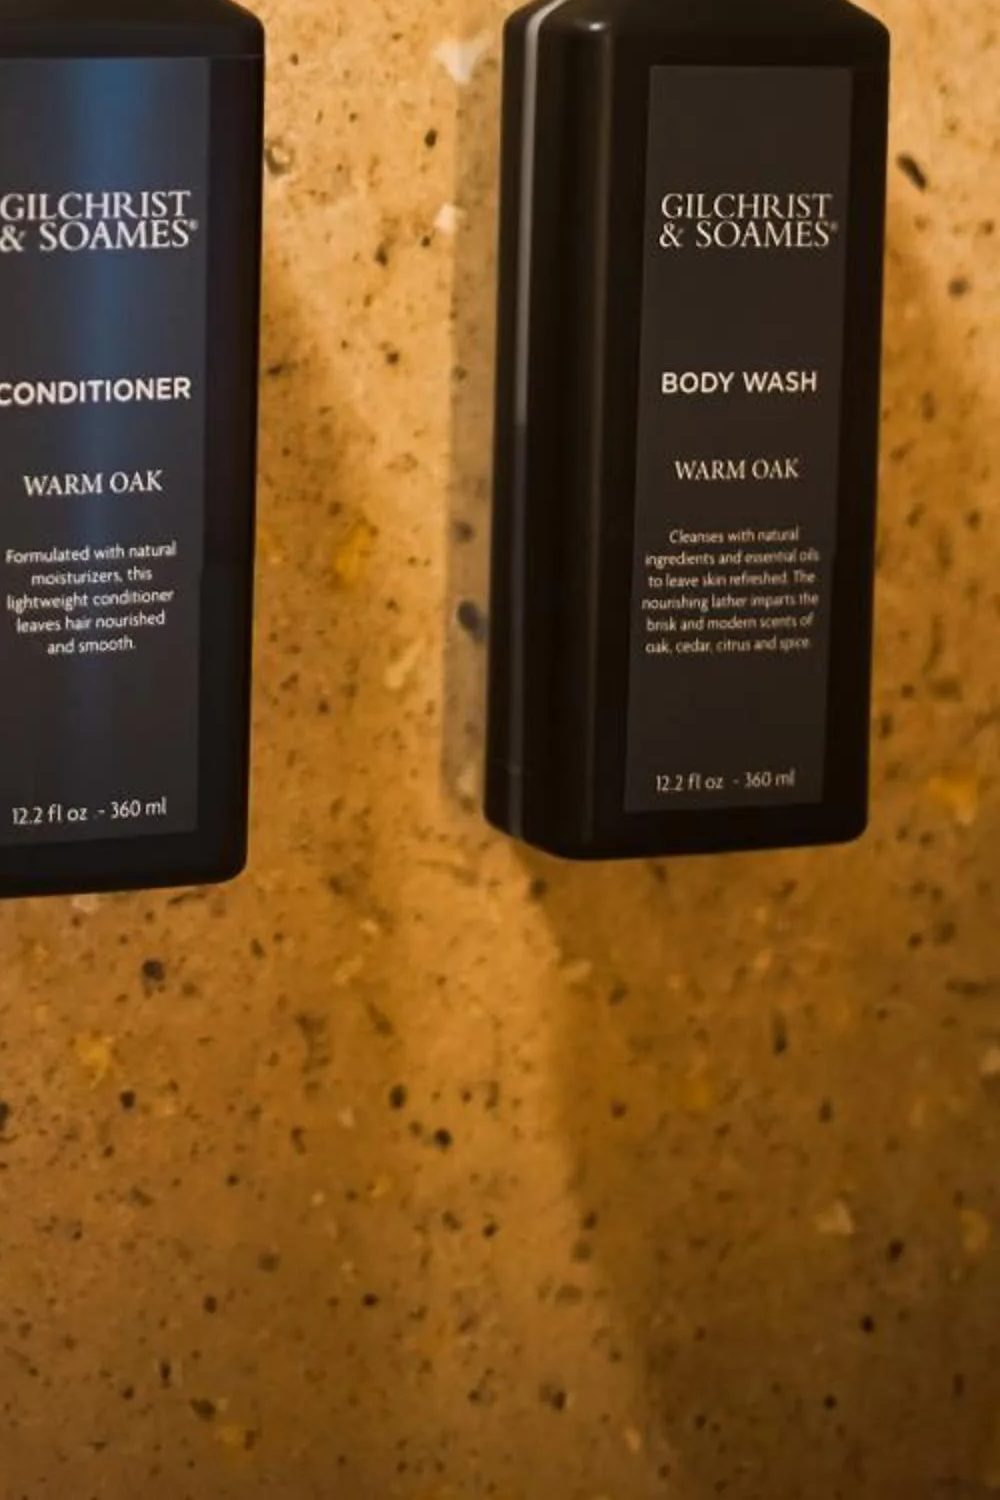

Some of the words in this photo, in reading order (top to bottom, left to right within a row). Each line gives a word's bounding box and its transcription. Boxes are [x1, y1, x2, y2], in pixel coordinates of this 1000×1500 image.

[0, 190, 192, 221] GILCHRIST
[661, 192, 834, 219] GILCHRIST
[659, 221, 684, 248] &
[661, 371, 735, 394] BODY
[742, 370, 818, 393] WASH
[674, 459, 746, 481] WARM
[751, 457, 800, 479] OAK
[23, 473, 102, 497] WARM
[109, 469, 163, 493] OAK
[669, 528, 724, 544] Cleanses
[727, 527, 755, 543] with
[757, 525, 800, 542] natural
[5, 545, 90, 564] Formulated
[93, 543, 125, 560] with
[128, 540, 177, 558] natural
[645, 551, 715, 570] ingredients
[718, 549, 742, 565] and
[127, 565, 153, 582] this
[648, 574, 663, 588] to
[665, 573, 699, 588] leave
[702, 571, 727, 586] skin
[792, 569, 816, 584] The
[6, 591, 89, 614] lightweight
[92, 588, 175, 605] conditioner
[642, 594, 709, 612] nourishing
[711, 593, 746, 609] lather
[751, 592, 796, 610] imparts
[799, 591, 819, 606] the
[16, 617, 62, 633] leaves
[65, 614, 91, 631] hair
[95, 608, 166, 629] nourished
[646, 616, 677, 633] brisk
[680, 616, 704, 632] and
[707, 614, 757, 630] modern
[760, 613, 797, 629] scents
[799, 611, 814, 627] of
[47, 637, 75, 655] and
[78, 635, 136, 654] smooth.
[716, 637, 750, 652] citrus
[753, 634, 777, 651] and
[656, 773, 683, 792] 12.2
[688, 771, 701, 790] fl
[705, 775, 724, 790] oz
[744, 770, 772, 789] 360
[775, 768, 795, 787] ml
[11, 806, 43, 825] 12.2
[48, 804, 62, 823] fl
[66, 807, 89, 822] oz
[110, 799, 142, 819] 360
[145, 796, 168, 816] ml
